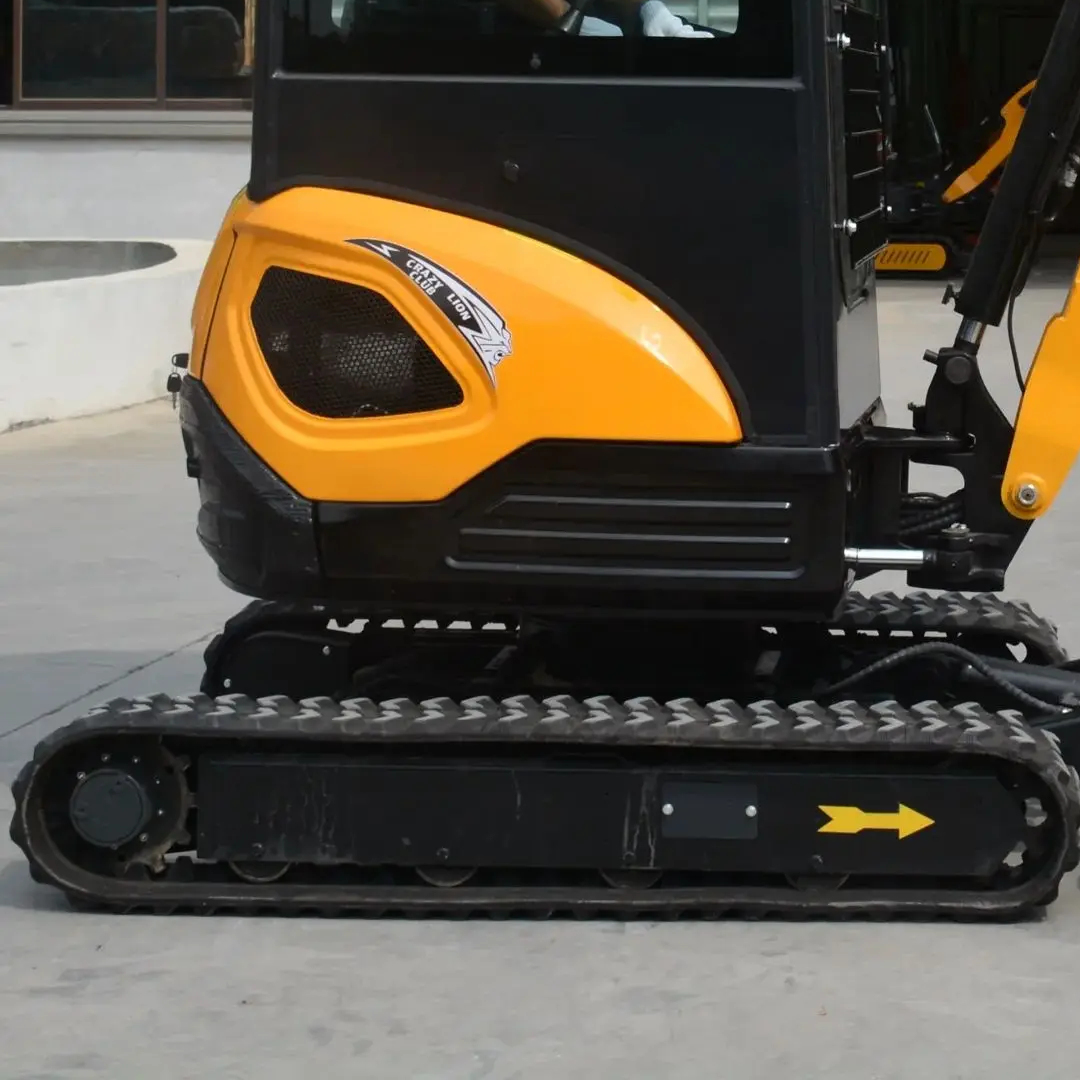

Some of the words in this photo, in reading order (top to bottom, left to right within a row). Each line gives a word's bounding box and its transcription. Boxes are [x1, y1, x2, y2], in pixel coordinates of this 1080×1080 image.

[406, 259, 444, 289] CRAZY
[447, 294, 472, 321] LION
[409, 271, 436, 295] CLUB
